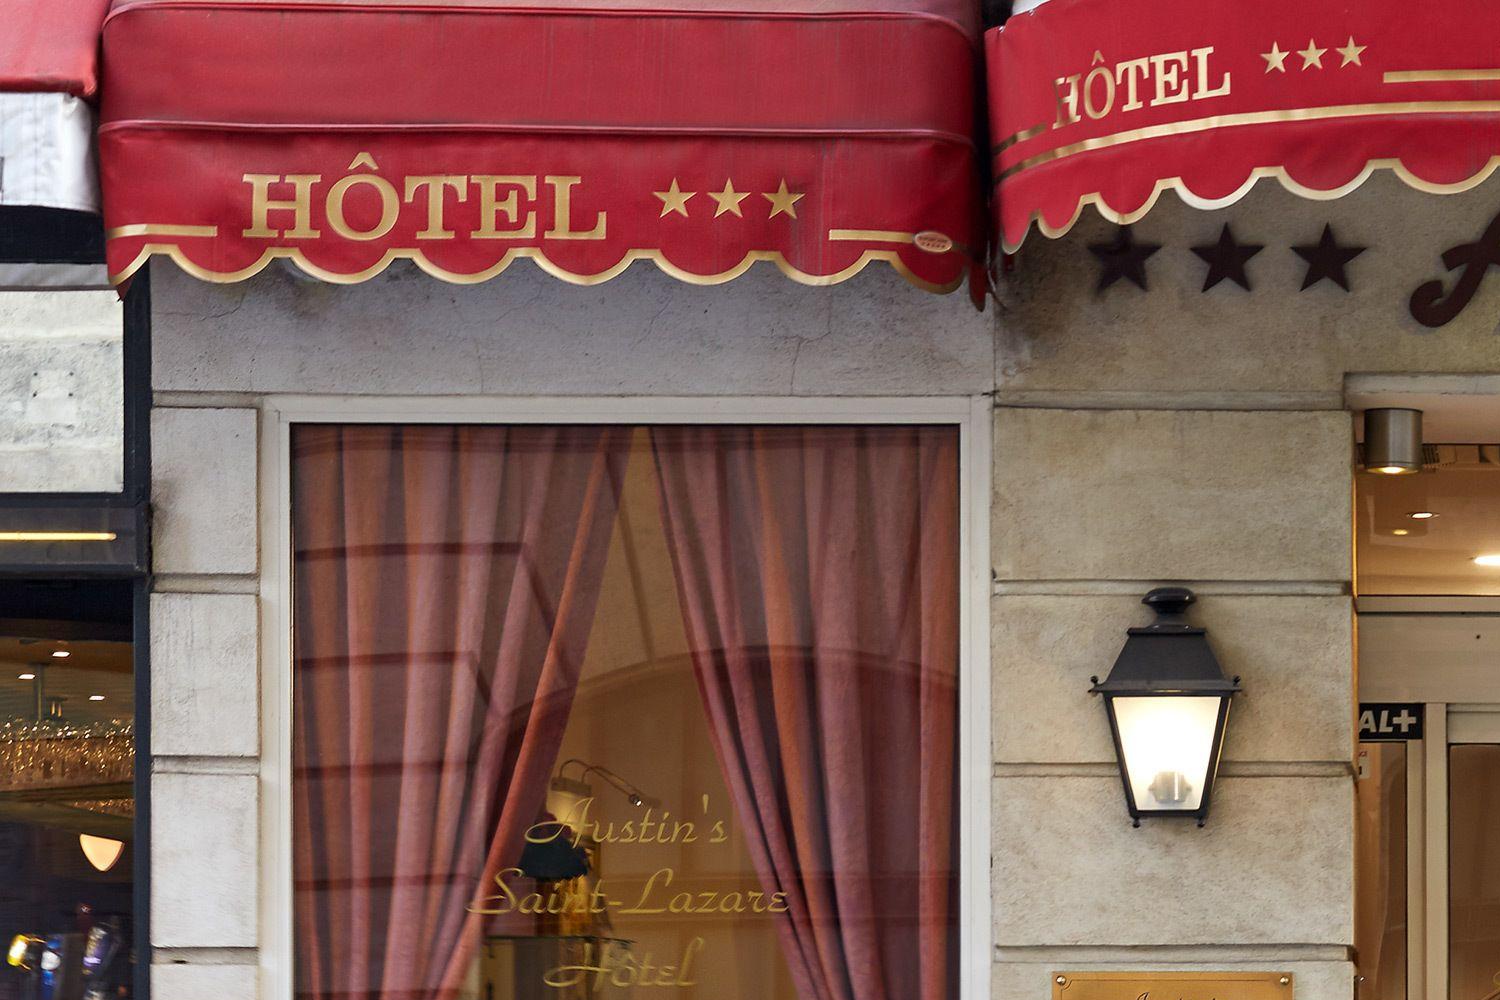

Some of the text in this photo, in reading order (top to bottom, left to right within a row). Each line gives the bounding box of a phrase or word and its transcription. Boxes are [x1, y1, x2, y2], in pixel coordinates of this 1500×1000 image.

[1052, 46, 1232, 131] HÔTEL
[242, 152, 607, 241] HÔTEL
[524, 794, 729, 850] Austin's
[465, 867, 790, 915] Saint-Lazare
[543, 937, 705, 991] Hôtel
